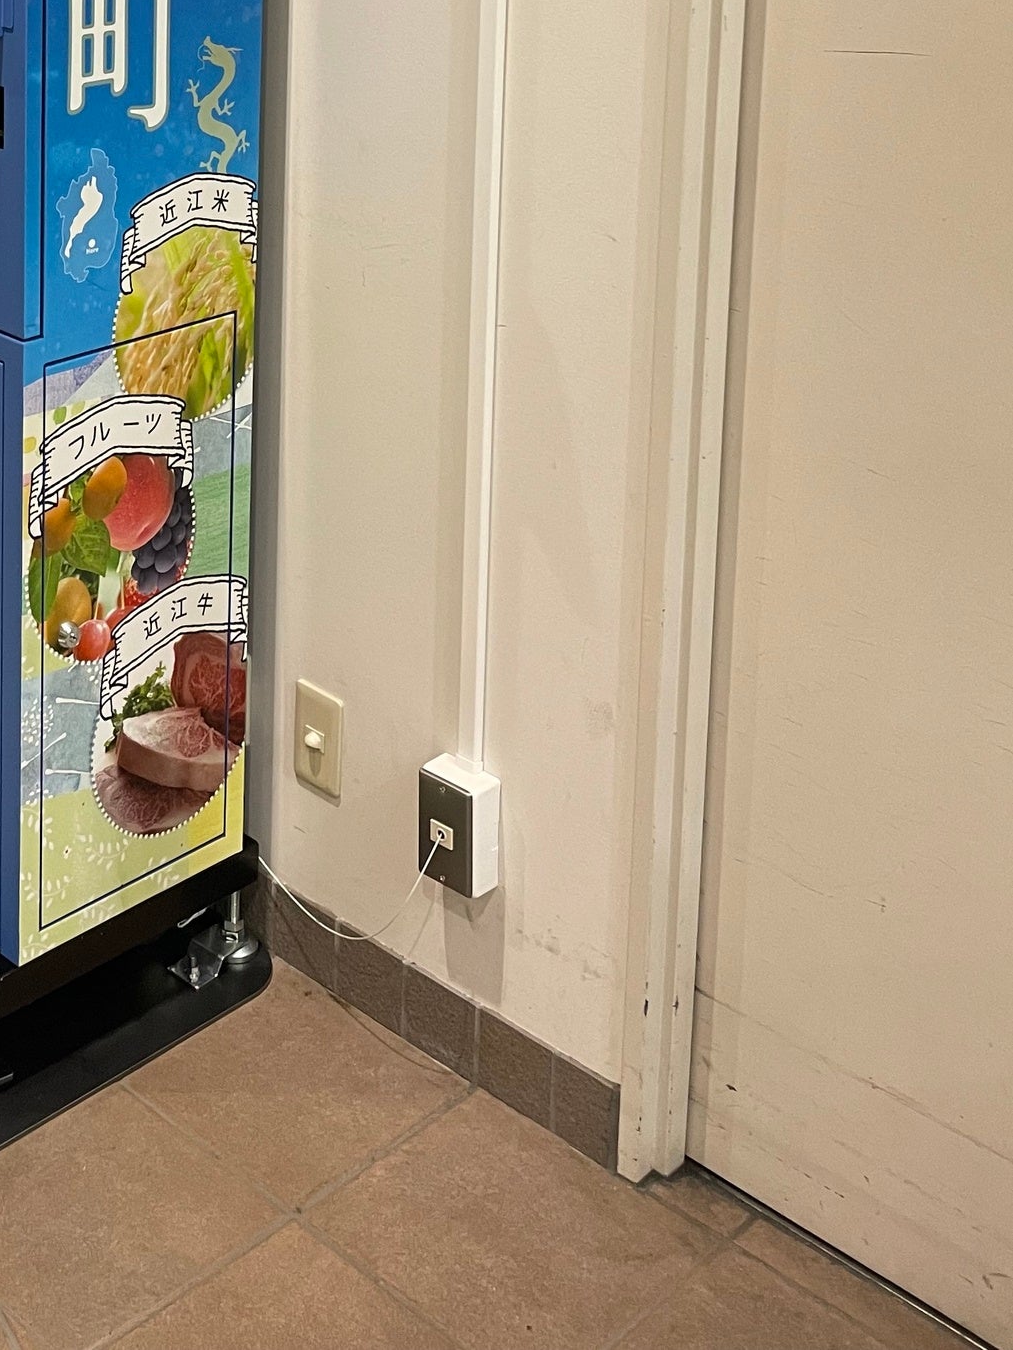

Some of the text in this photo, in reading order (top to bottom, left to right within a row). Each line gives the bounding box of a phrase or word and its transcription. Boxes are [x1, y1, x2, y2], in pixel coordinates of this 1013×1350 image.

[159, 189, 230, 227] 近江米
[68, 413, 162, 460] フルーツ
[143, 593, 214, 640] 近江牛
